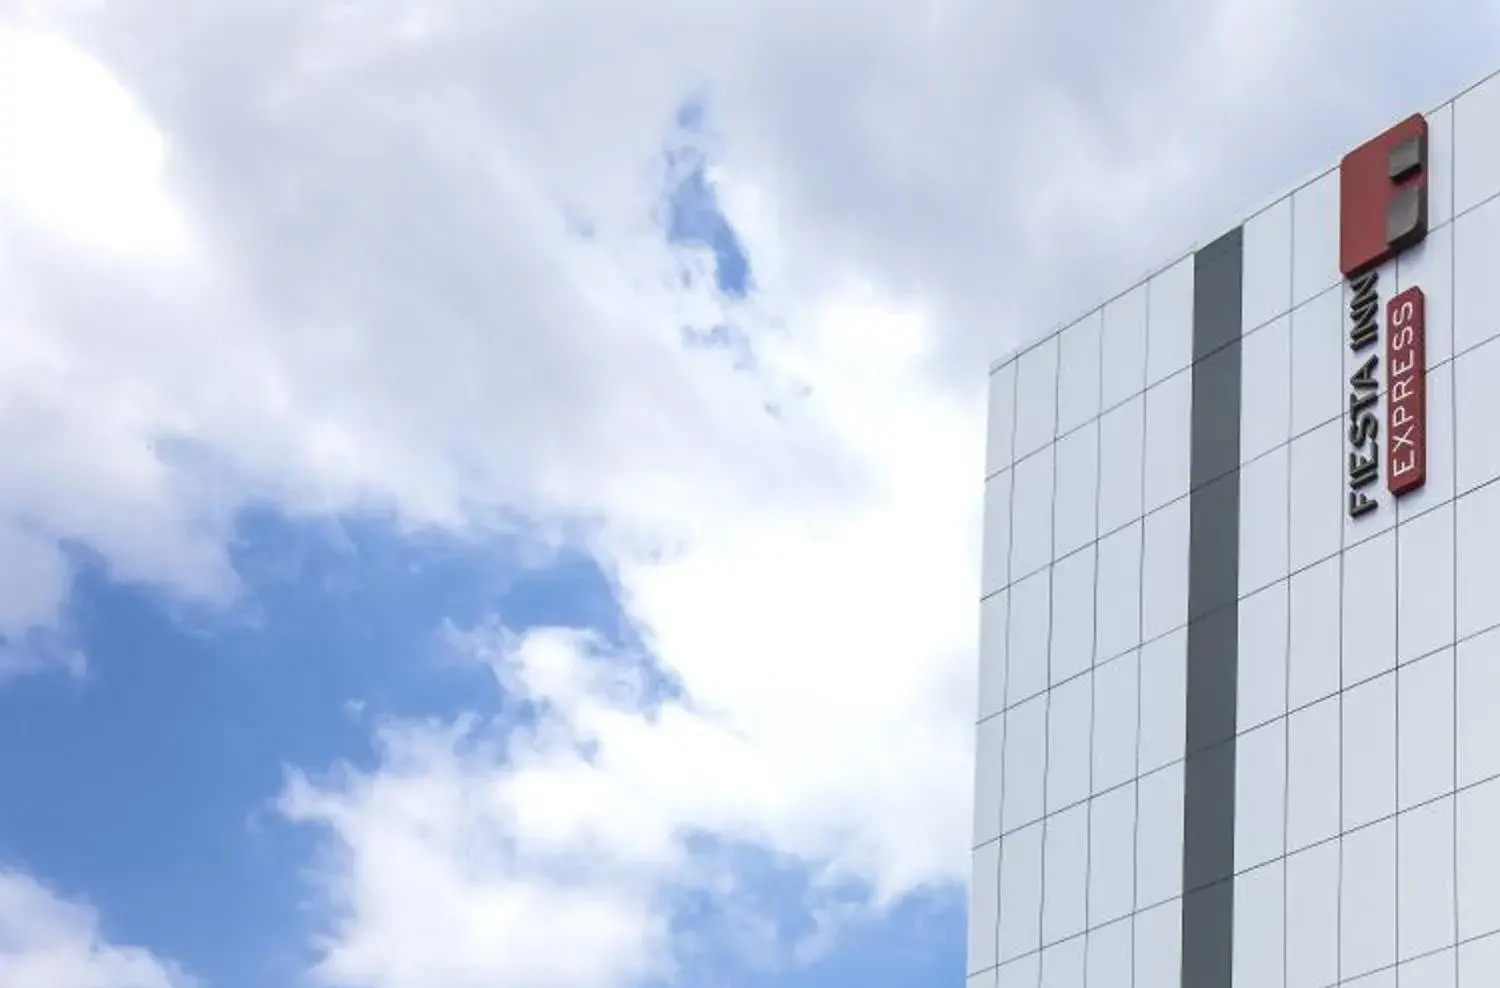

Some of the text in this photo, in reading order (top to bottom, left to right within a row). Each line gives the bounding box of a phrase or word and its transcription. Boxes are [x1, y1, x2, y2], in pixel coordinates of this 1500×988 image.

[1349, 271, 1379, 519] FIESTA INN
[1391, 301, 1415, 478] EXPRESS
